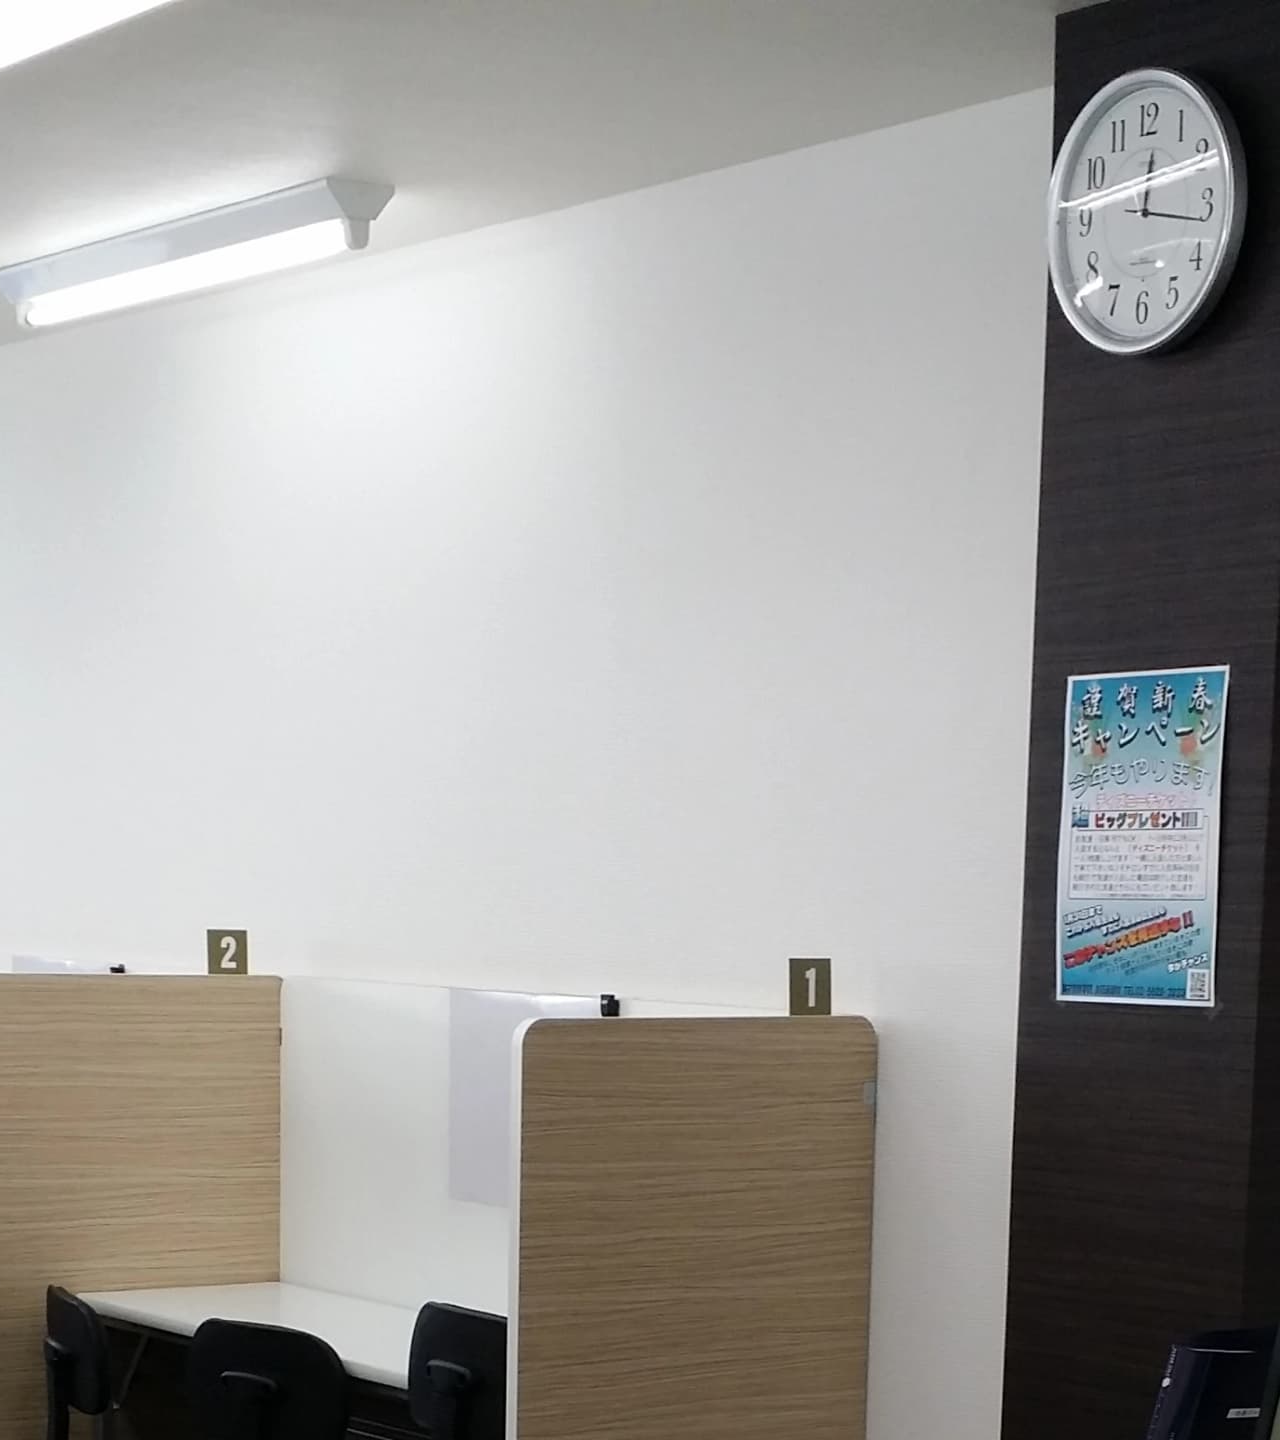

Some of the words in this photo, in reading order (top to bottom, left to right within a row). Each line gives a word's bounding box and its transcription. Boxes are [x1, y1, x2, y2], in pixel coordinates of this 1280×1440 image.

[1111, 119, 1126, 153] 11
[1140, 102, 1159, 137] 12
[1178, 109, 1184, 142] 1
[1087, 156, 1105, 190] 10
[1079, 206, 1093, 237] 9
[1200, 187, 1214, 222] 3
[1189, 241, 1202, 271] 4
[1108, 284, 1121, 317] 7
[1135, 290, 1149, 324] 6
[1166, 276, 1179, 310] 5
[1071, 717, 1221, 753] キャンペーン
[219, 937, 239, 969] 2
[803, 967, 817, 1008] 1
